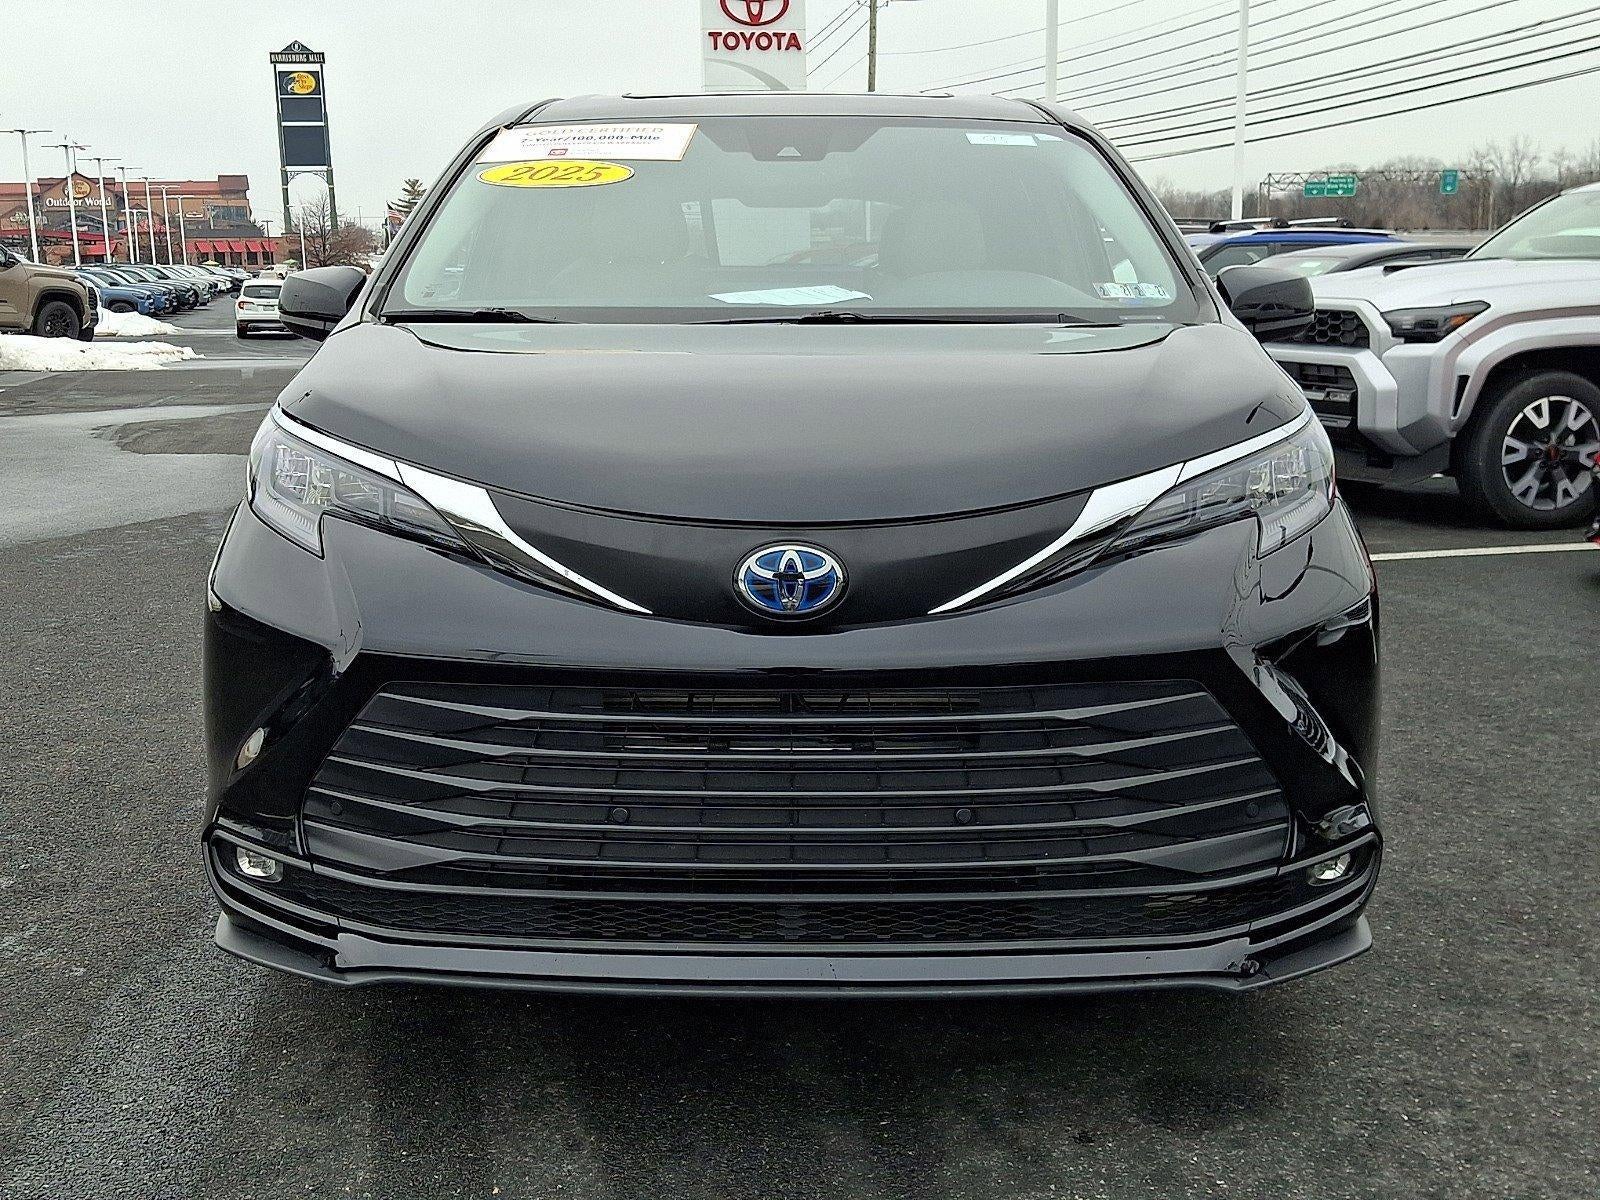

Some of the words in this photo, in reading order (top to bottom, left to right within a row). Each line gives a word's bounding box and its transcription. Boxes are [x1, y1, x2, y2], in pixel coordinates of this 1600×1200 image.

[708, 31, 802, 51] TOYOTA
[309, 54, 323, 62] MALL
[500, 166, 611, 182] 2025
[85, 197, 111, 206] Word
